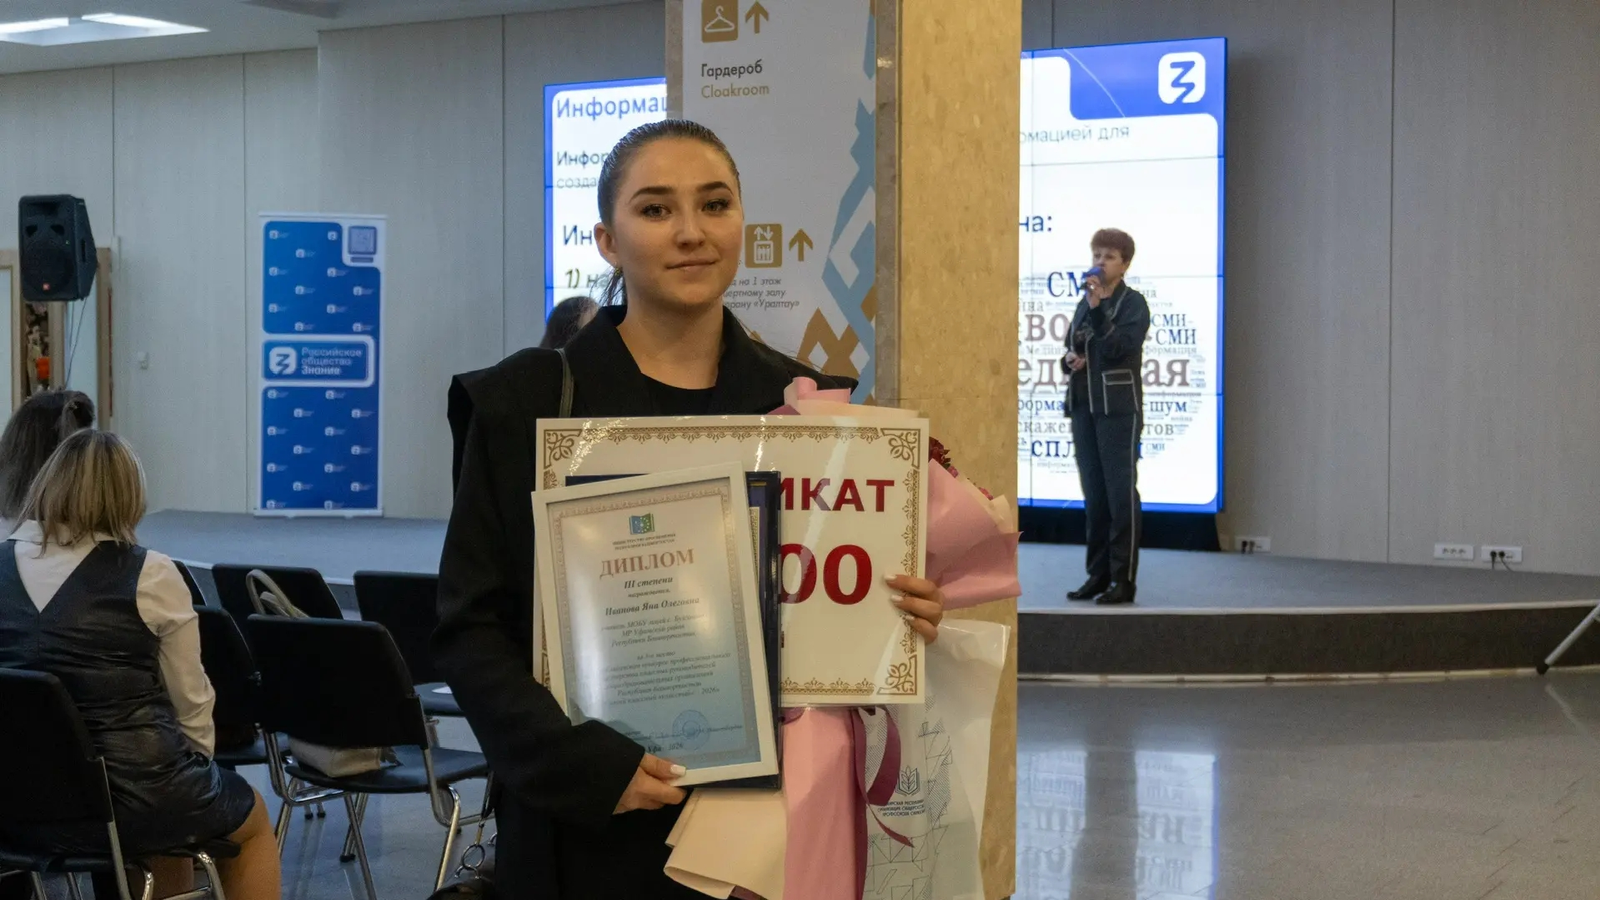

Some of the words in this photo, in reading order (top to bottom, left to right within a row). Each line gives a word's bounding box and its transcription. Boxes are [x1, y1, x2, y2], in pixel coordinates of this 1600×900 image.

[701, 59, 763, 79] Гардероб
[701, 84, 770, 98] Cloakroom
[1098, 126, 1130, 140] для
[565, 268, 580, 289] 1)
[752, 276, 758, 286] 1
[760, 278, 782, 286] этаж
[765, 290, 787, 299] залу
[301, 347, 362, 357] Российское
[301, 357, 352, 366] общество
[301, 366, 341, 375] Знание
[599, 548, 694, 579] ДИПЛОМ
[624, 580, 635, 589] III
[637, 577, 673, 588] степени
[605, 605, 640, 616] Иванова
[642, 602, 659, 611] Яна
[661, 598, 700, 608] Олеговна
